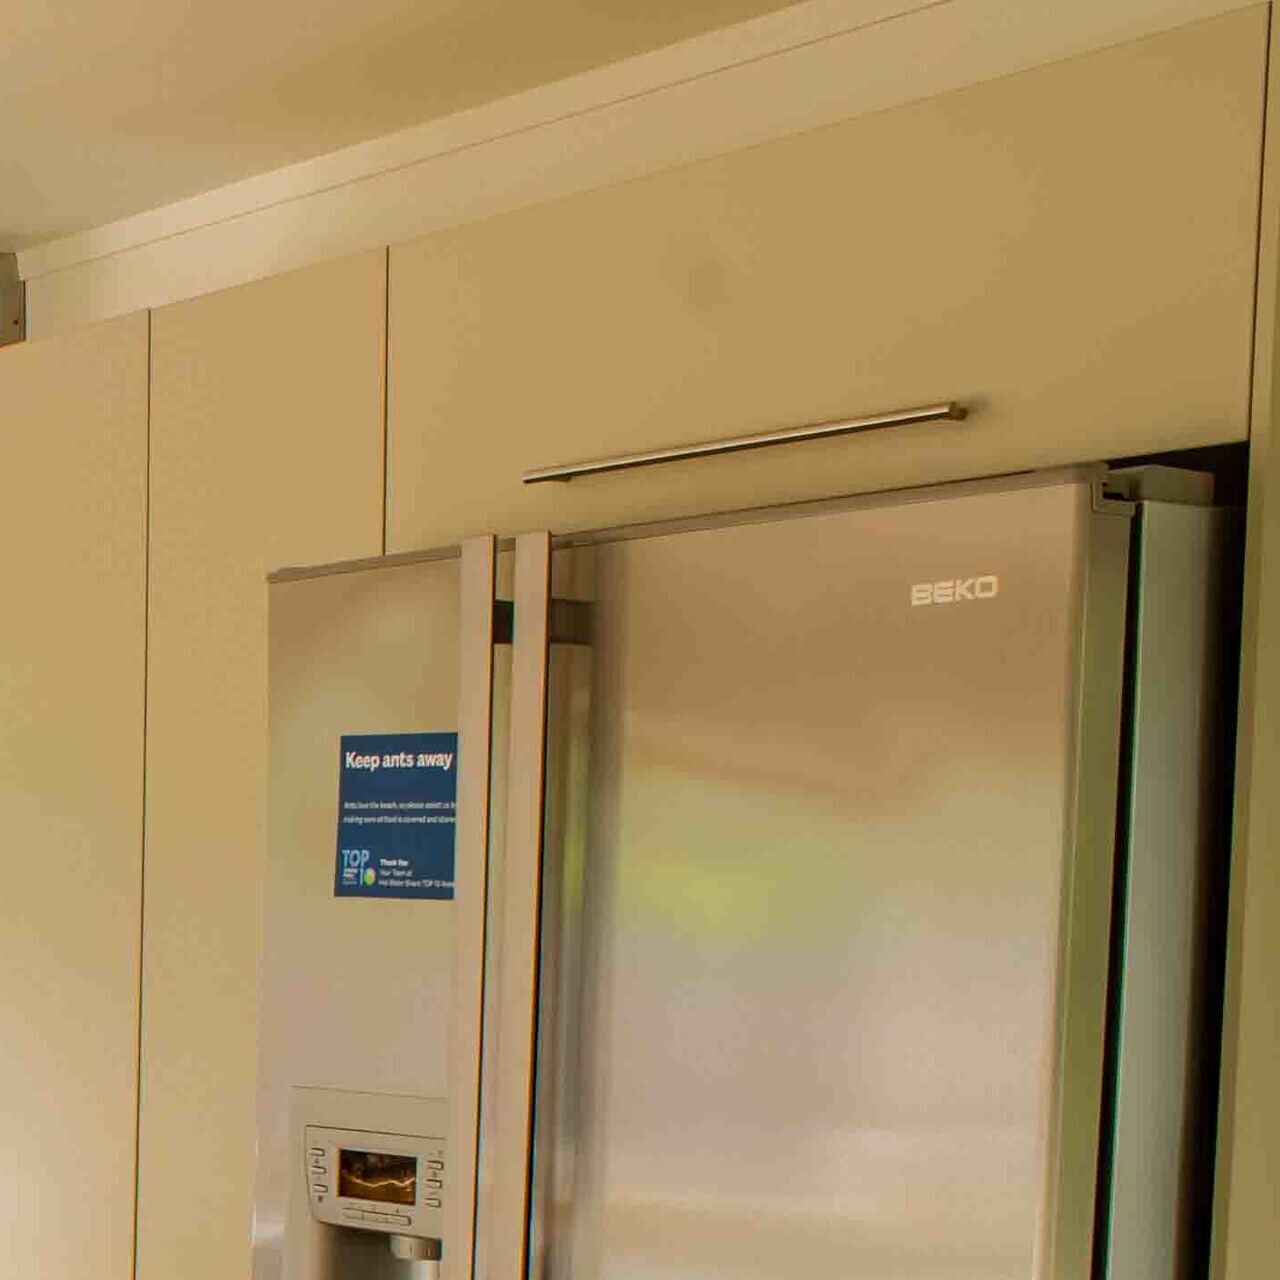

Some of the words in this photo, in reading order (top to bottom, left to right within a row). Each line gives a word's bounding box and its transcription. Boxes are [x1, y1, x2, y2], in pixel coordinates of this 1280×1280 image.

[911, 575, 998, 606] BEKO
[345, 751, 381, 771] Keep
[382, 752, 414, 768] ants
[417, 751, 453, 770] away
[342, 849, 370, 867] TOP
